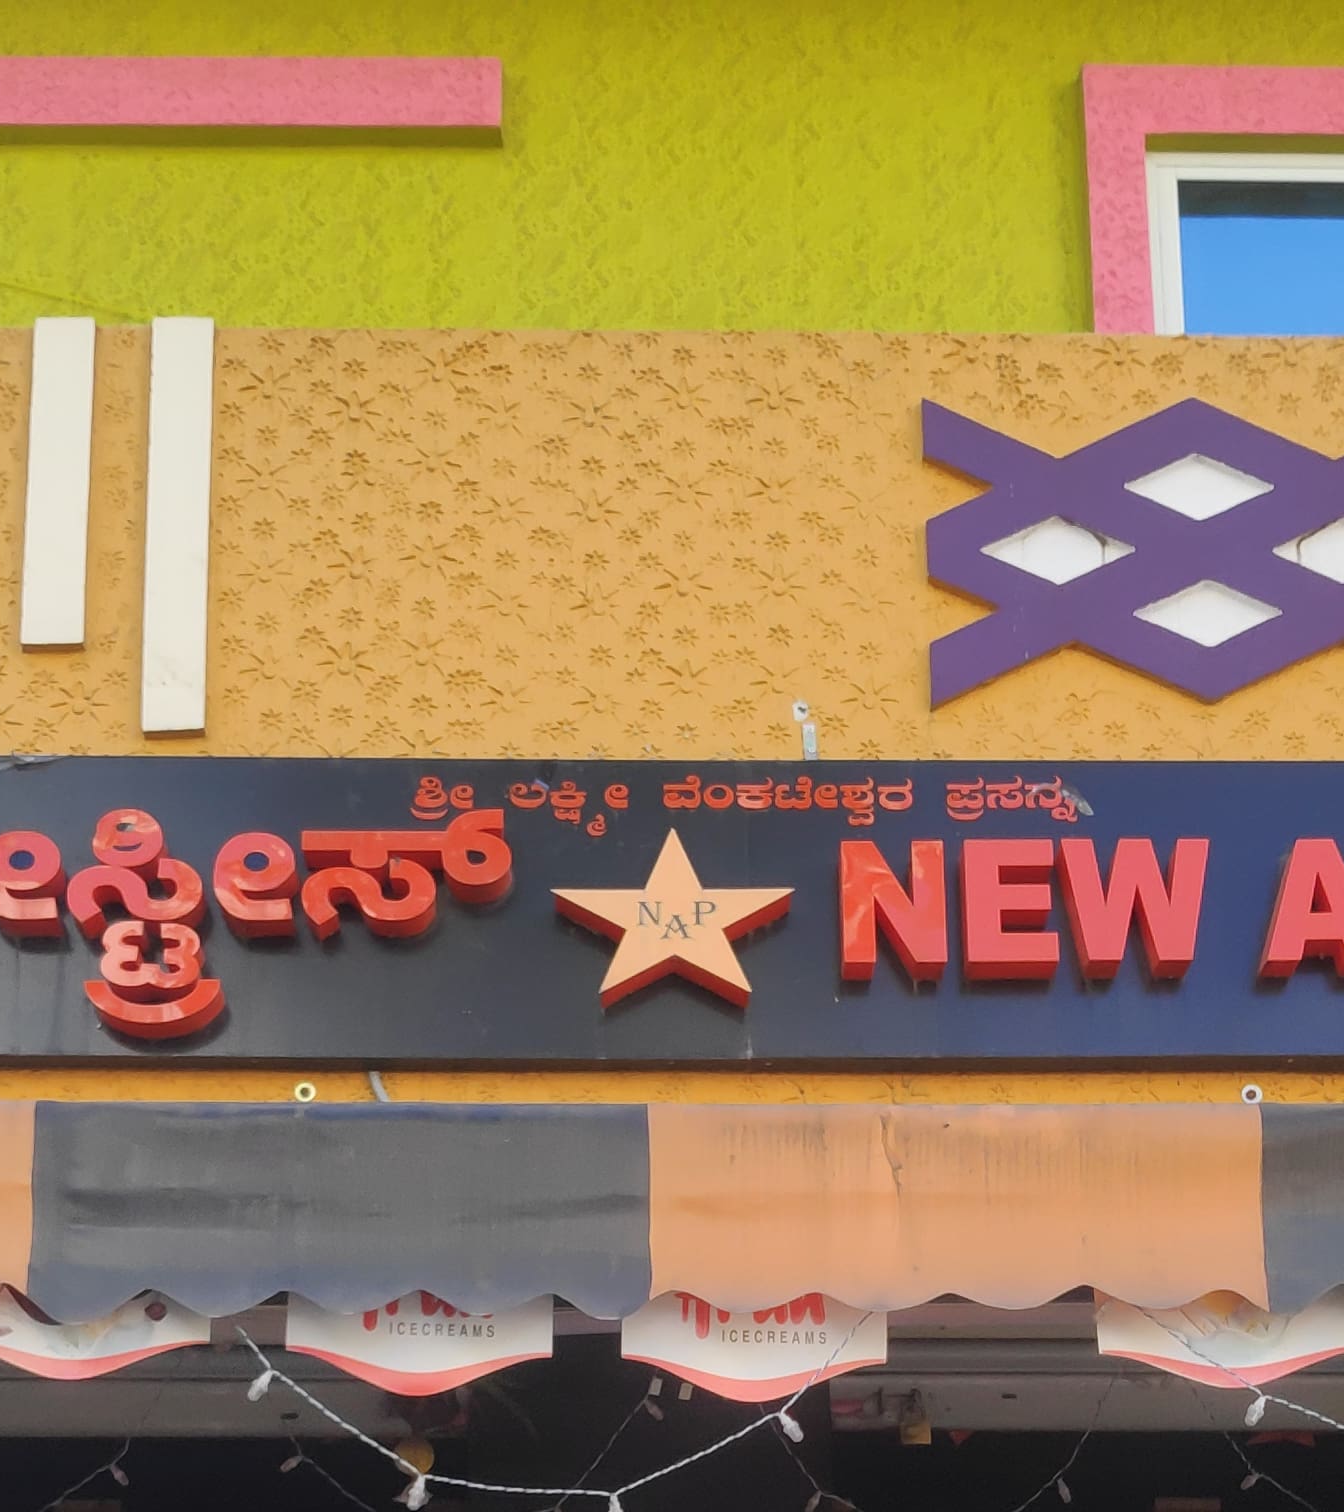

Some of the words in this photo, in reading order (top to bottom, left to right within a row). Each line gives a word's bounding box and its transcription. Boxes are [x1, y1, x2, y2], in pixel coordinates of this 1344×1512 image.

[411, 776, 475, 820] ಶ್ರೀ
[662, 775, 913, 826] ವೆಂಕಟೇಶ್ವರ
[944, 775, 1080, 822] ಪ್ರಸನ್ನ
[636, 900, 717, 940] NAP
[838, 836, 1210, 981] NEW
[388, 1321, 496, 1338] ICECREAMS
[721, 1329, 827, 1345] ICECREAMS
